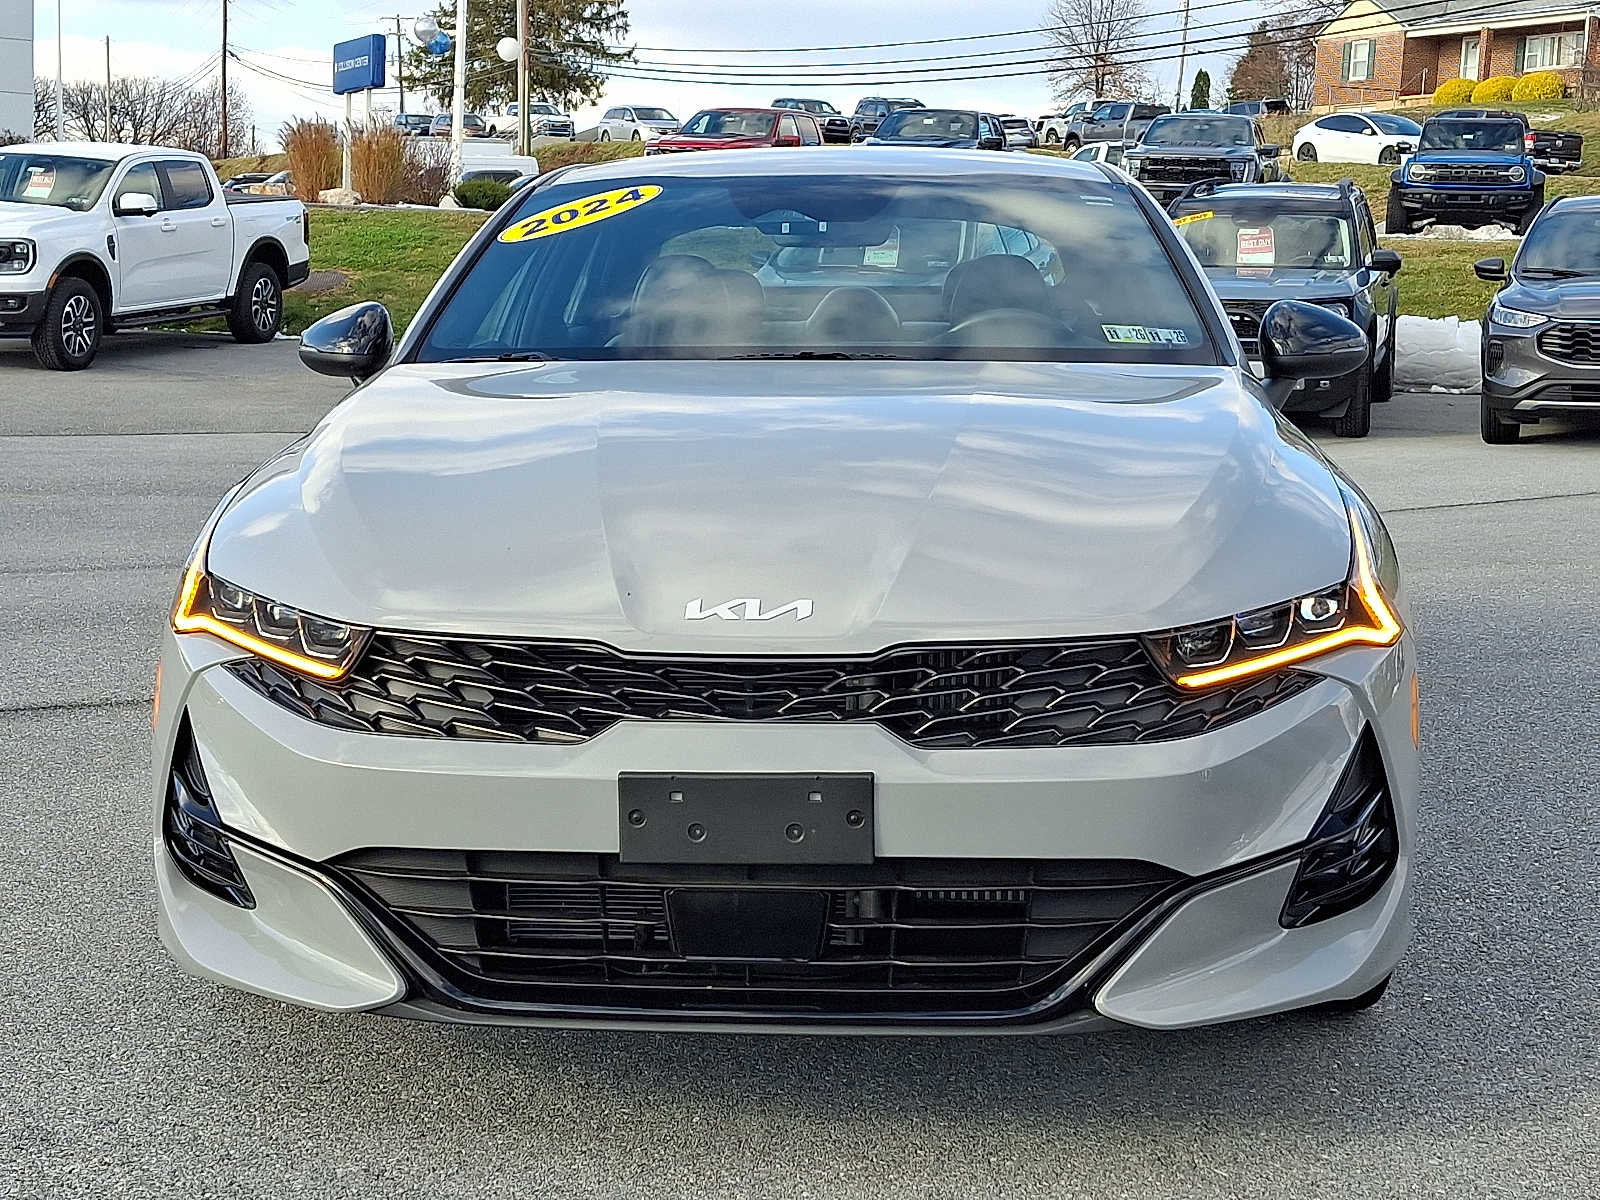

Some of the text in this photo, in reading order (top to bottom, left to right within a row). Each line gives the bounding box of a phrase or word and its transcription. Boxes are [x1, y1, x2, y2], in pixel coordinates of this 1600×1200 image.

[520, 188, 645, 238] 2024
[1107, 329, 1121, 340] 11
[1148, 331, 1162, 342] 11
[684, 597, 814, 621] KIA
